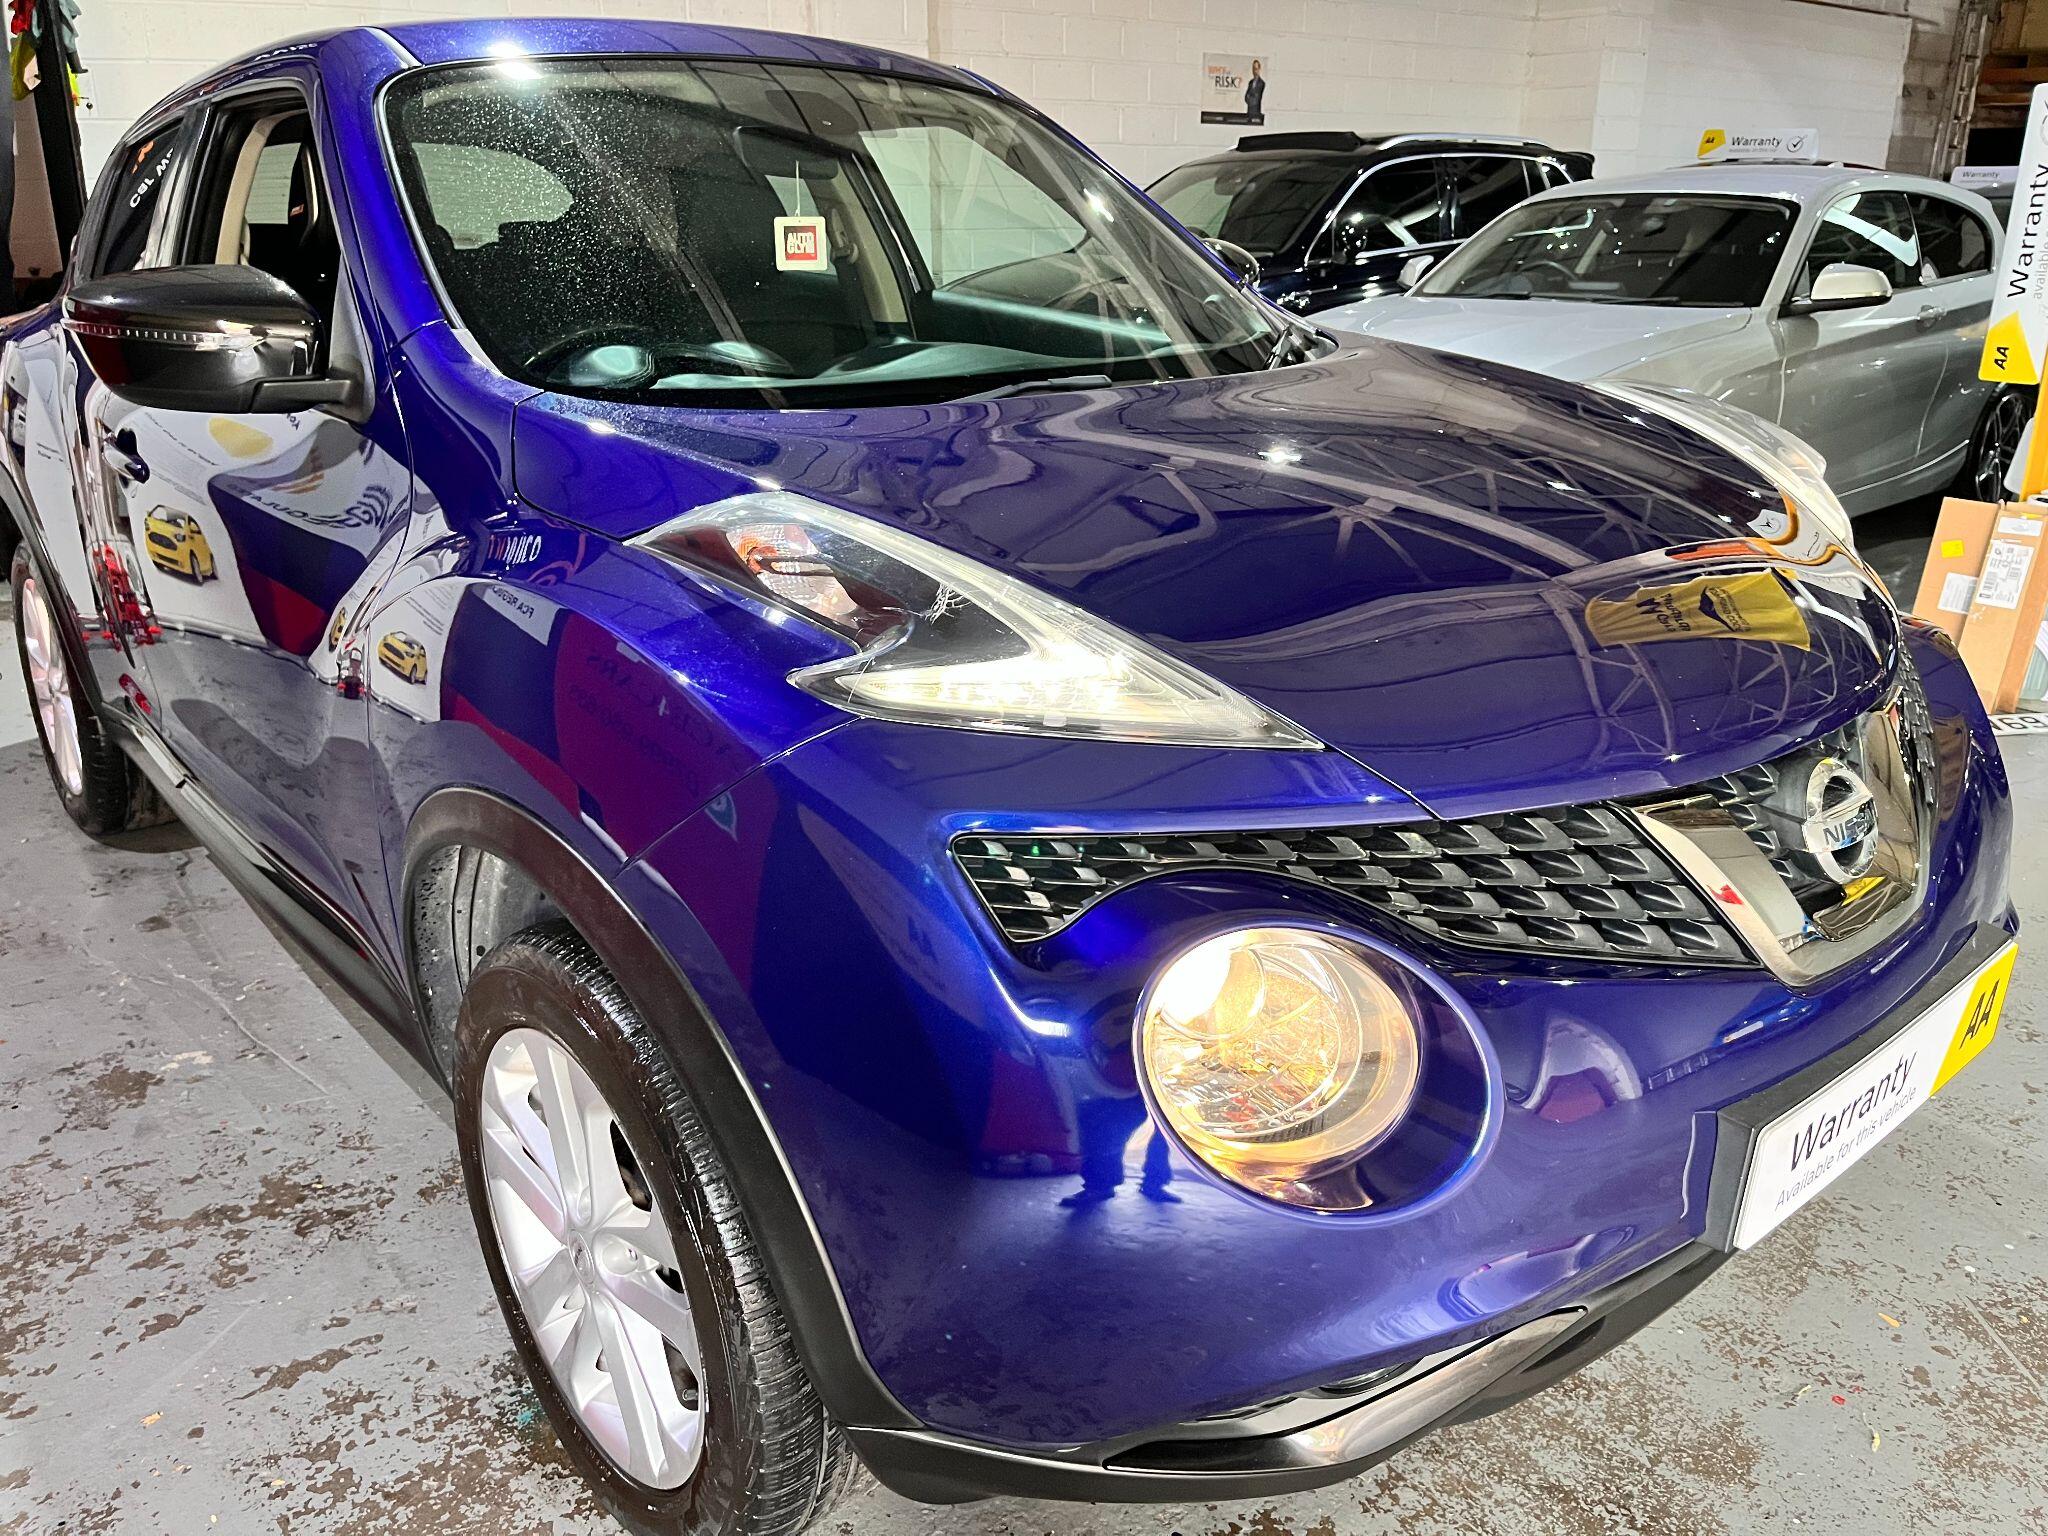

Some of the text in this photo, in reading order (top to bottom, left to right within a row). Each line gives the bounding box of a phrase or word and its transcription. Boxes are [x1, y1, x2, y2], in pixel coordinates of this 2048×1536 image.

[1731, 136, 1783, 148] Warranty
[2007, 164, 2048, 298] Warranty
[1994, 346, 2010, 371] AA
[1959, 978, 2000, 1049] AA
[1774, 1087, 1917, 1211] Available for this vehicle
[1790, 1051, 1918, 1172] Warranty
